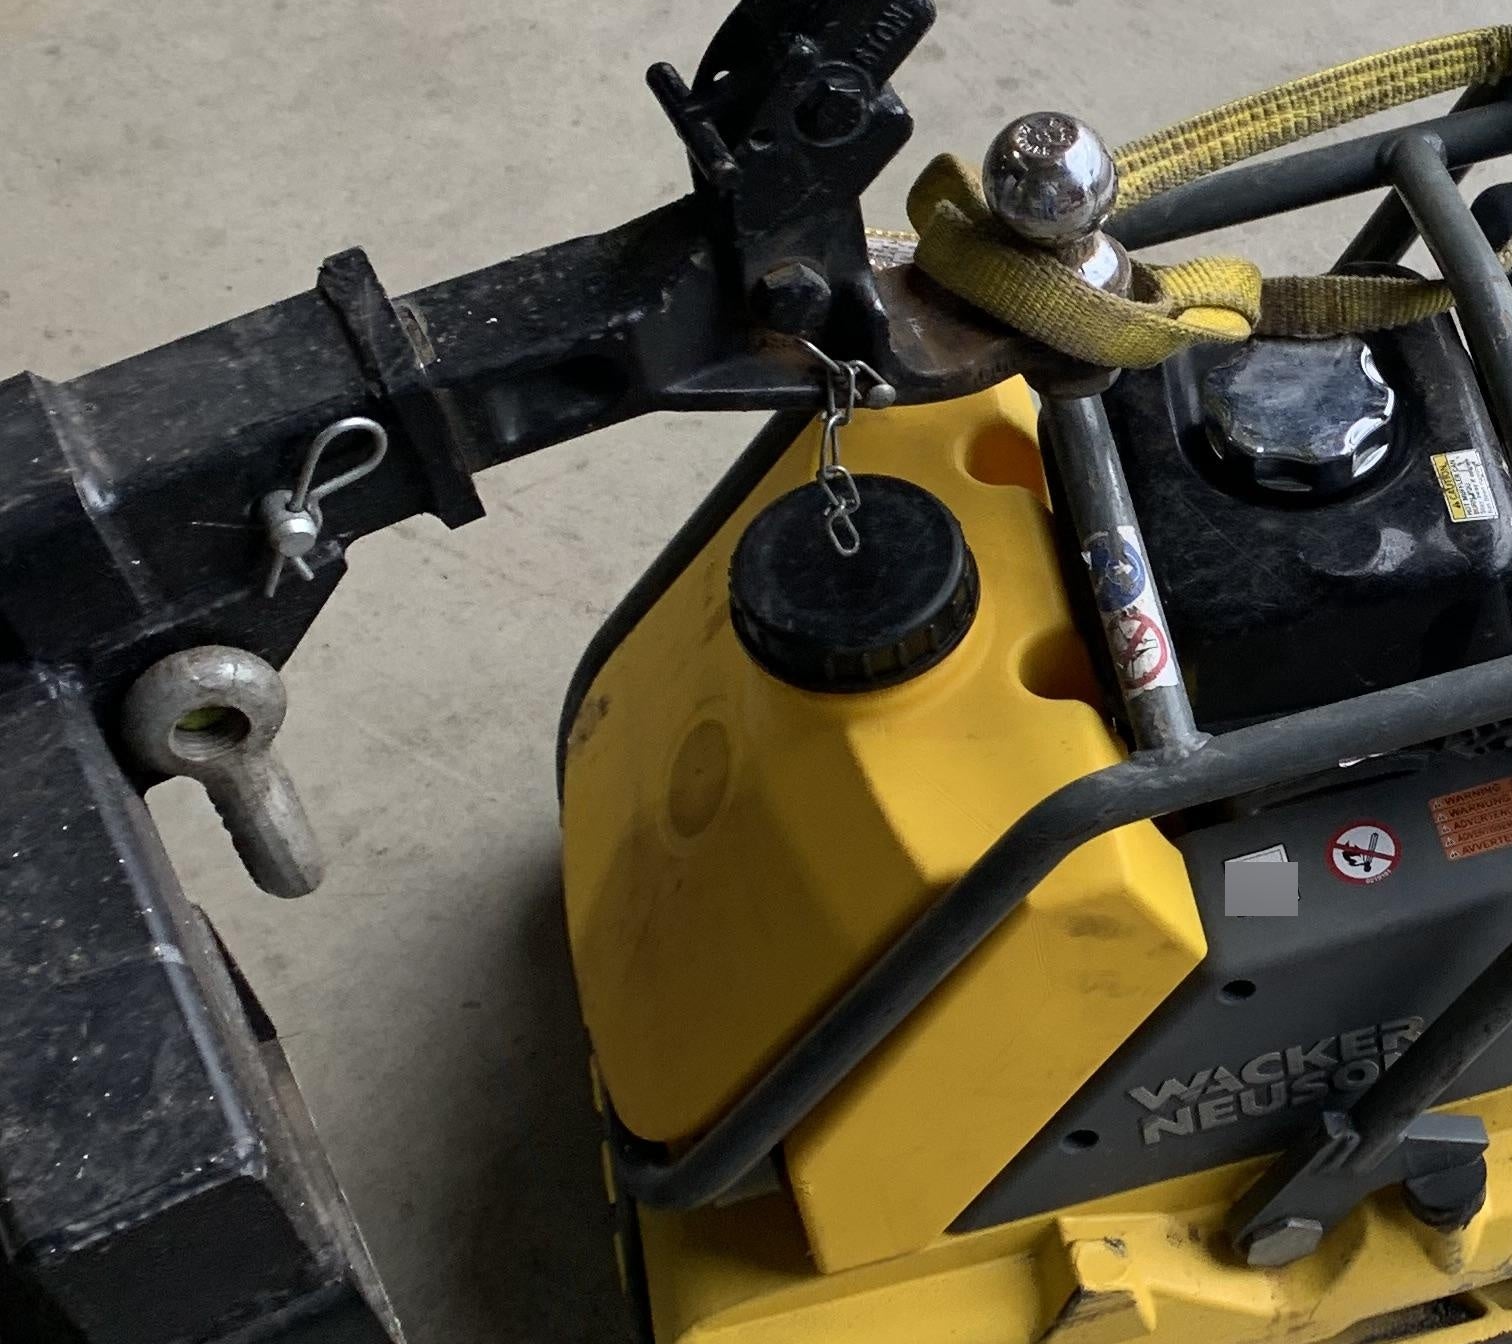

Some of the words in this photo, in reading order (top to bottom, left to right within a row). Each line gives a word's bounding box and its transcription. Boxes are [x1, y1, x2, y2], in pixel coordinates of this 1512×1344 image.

[1443, 781, 1502, 806] WARNING
[1128, 1016, 1424, 1111] WACKER
[1143, 1053, 1400, 1144] NEUSO
